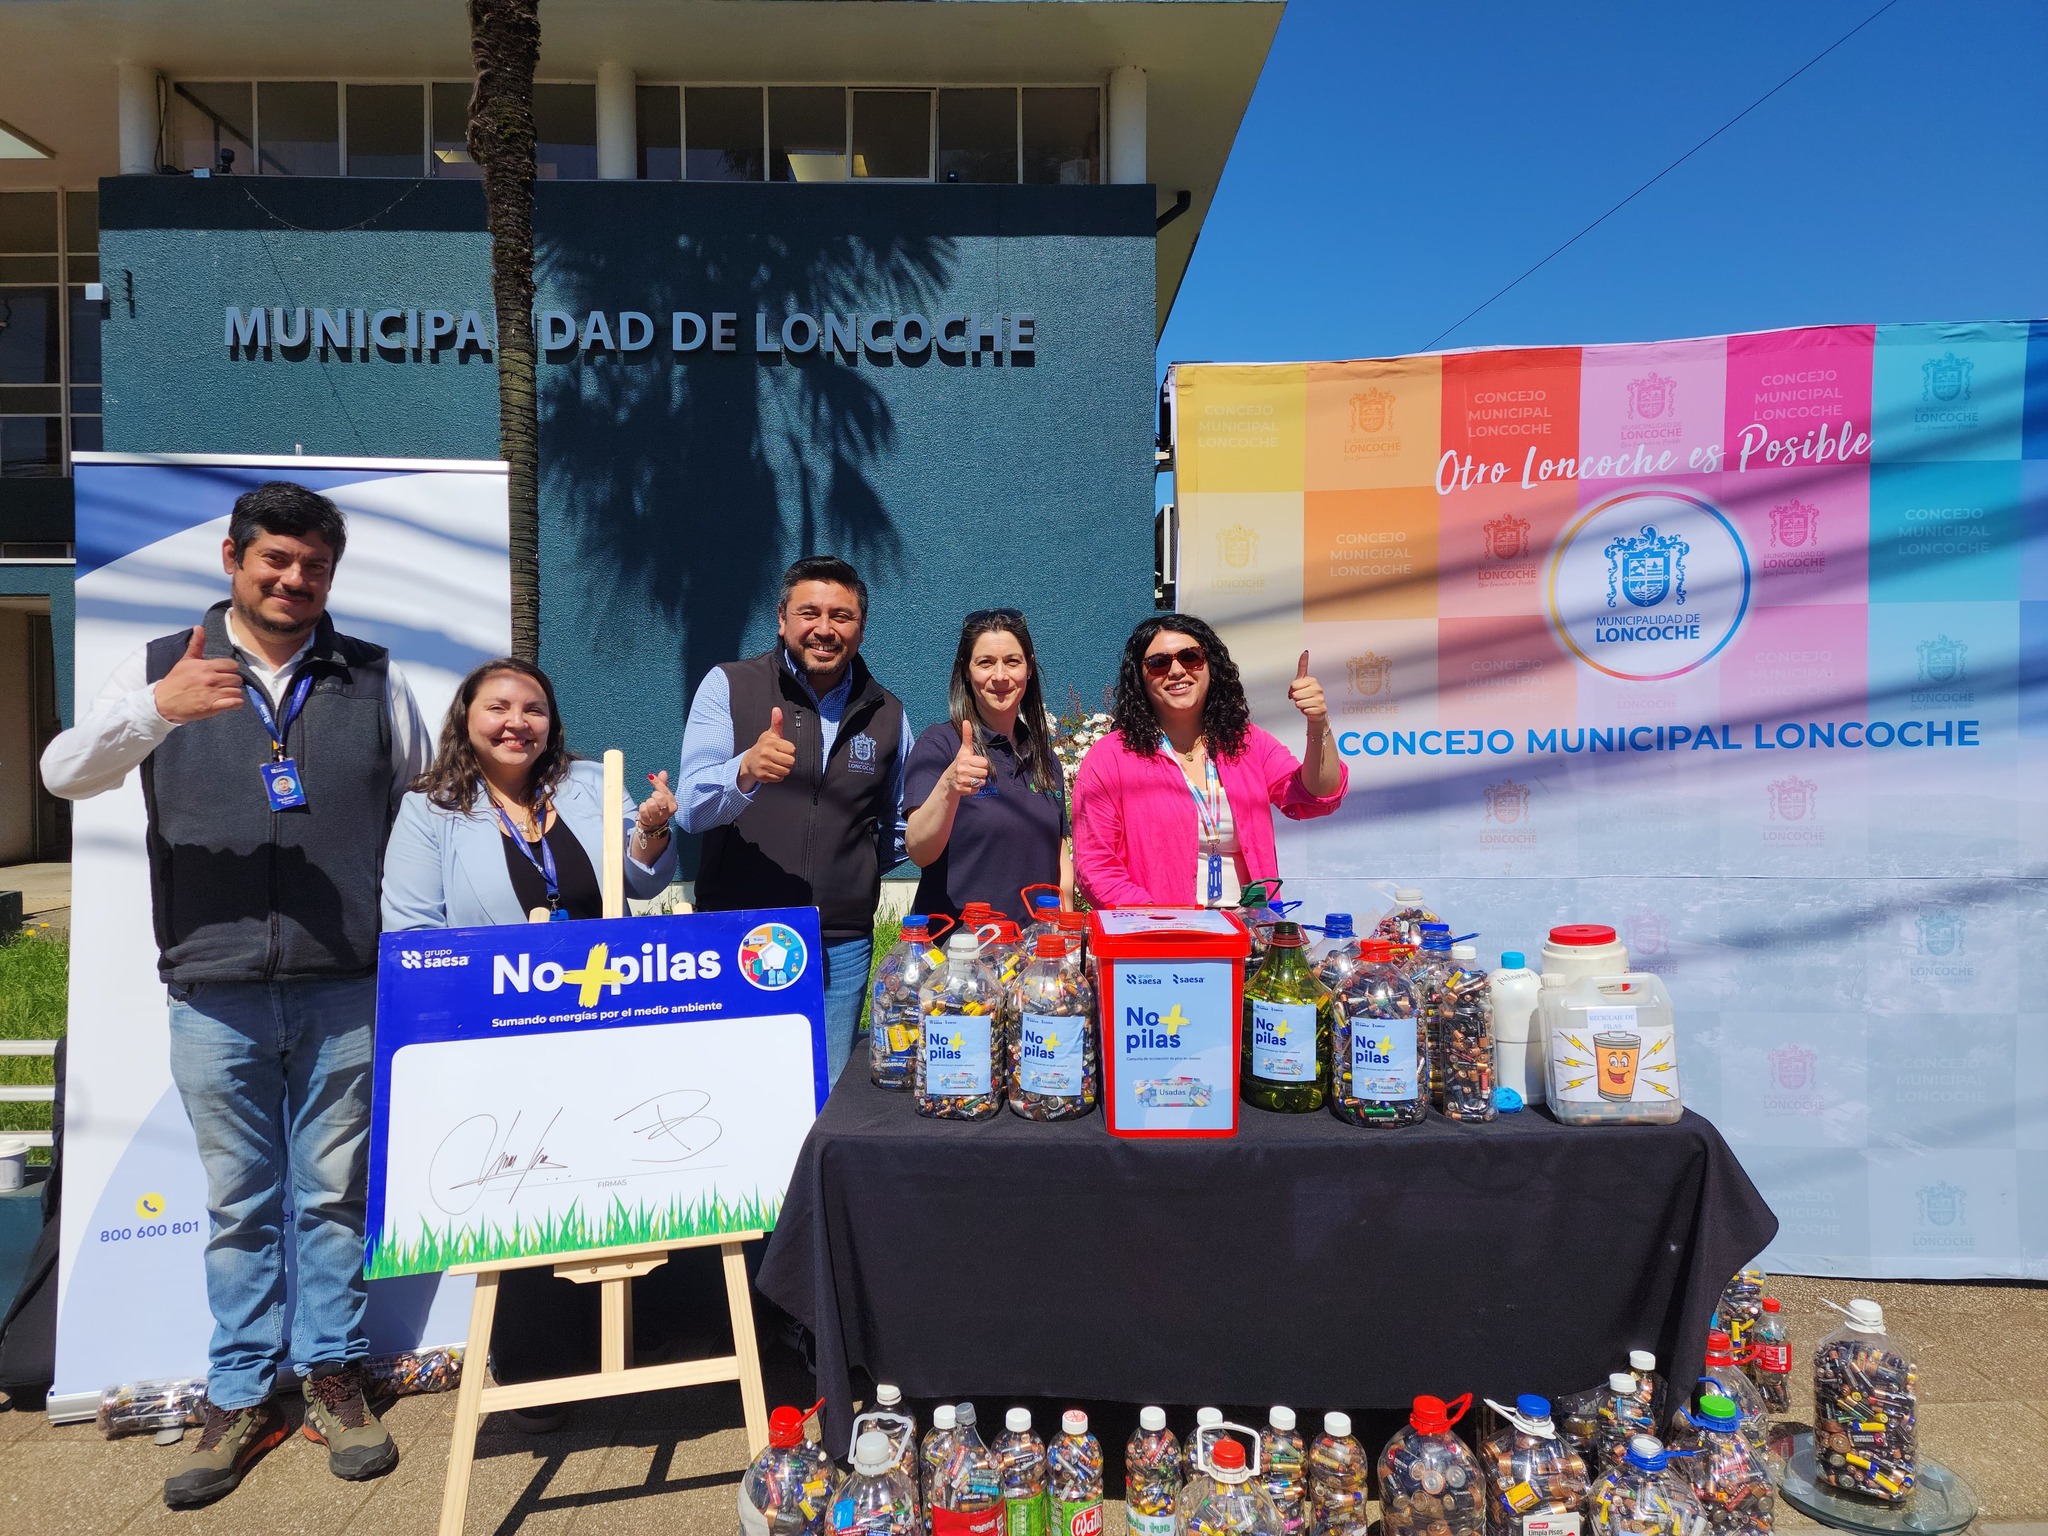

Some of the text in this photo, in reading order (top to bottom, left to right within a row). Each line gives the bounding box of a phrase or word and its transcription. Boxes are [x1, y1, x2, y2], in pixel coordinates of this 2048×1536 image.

[225, 307, 1035, 353] MUNICIPADAD DE LONCOCHE
[1761, 370, 1837, 386] CONCEJO
[1474, 391, 1546, 404] CONCEJO
[1754, 388, 1843, 404] MUNICIPAL
[1204, 405, 1273, 416] CONCEJO
[1468, 407, 1552, 421] MUNICIPAL
[1753, 405, 1842, 421] LONCOCHE
[1914, 411, 1979, 423] LONCOCHE
[1199, 421, 1279, 433] MUNICIPAL
[1467, 424, 1552, 438] LONCOCHE
[1621, 428, 1682, 440] LONCOCHE
[1199, 436, 1279, 448] LONCOCHE
[1344, 442, 1400, 453] LONCOCHE
[1435, 421, 1875, 495] Otro Loncoche es Posible
[1905, 508, 1983, 521] CONCEJO
[1336, 532, 1406, 544] CONCEJO
[1898, 525, 1990, 538] MUNICIPAL
[1330, 548, 1412, 560] MUNICIPAL
[1898, 542, 1990, 555] LONCOCHE
[1763, 558, 1825, 568] LONCOCHE
[1330, 564, 1412, 577] LONCOCHE
[1478, 569, 1537, 580] LONCOCHE
[1596, 613, 1700, 626] MUNICIPALIDAD DE
[1596, 625, 1700, 642] LONCOCHE
[1755, 651, 1832, 664] CONCEJO
[1471, 660, 1544, 673] CONCEJO
[1749, 667, 1836, 681] MUNICIPAL
[1465, 676, 1549, 688] MUNICIPAL
[1911, 693, 1975, 703] LONCOCHE
[1342, 705, 1399, 715] LONCOCHE
[1337, 721, 1980, 756] CONCEJO MUNICIPAL LONCOCHE
[1479, 834, 1538, 843] LONCOCHE
[1763, 831, 1825, 841] LONCOCHE
[424, 948, 453, 959] grupo
[424, 956, 469, 969] saesa
[1910, 966, 1974, 977] LONCOCHE
[491, 1002, 723, 1028] Sumando energías por el medio ambiente
[1126, 1028, 1181, 1054] pilas
[1256, 1032, 1287, 1046] pilas
[930, 1048, 961, 1061] pilas
[1024, 1046, 1055, 1059] pilas
[1355, 1050, 1390, 1064] pilas
[1903, 1058, 1979, 1069] CONCEJO
[1896, 1074, 1986, 1086] MUNICIPAL
[1896, 1091, 1986, 1103] LONCOCHE
[1763, 1100, 1825, 1110] LONCOCHE
[597, 1179, 627, 1189] FIRMAS
[100, 1221, 199, 1243] 800 600 801
